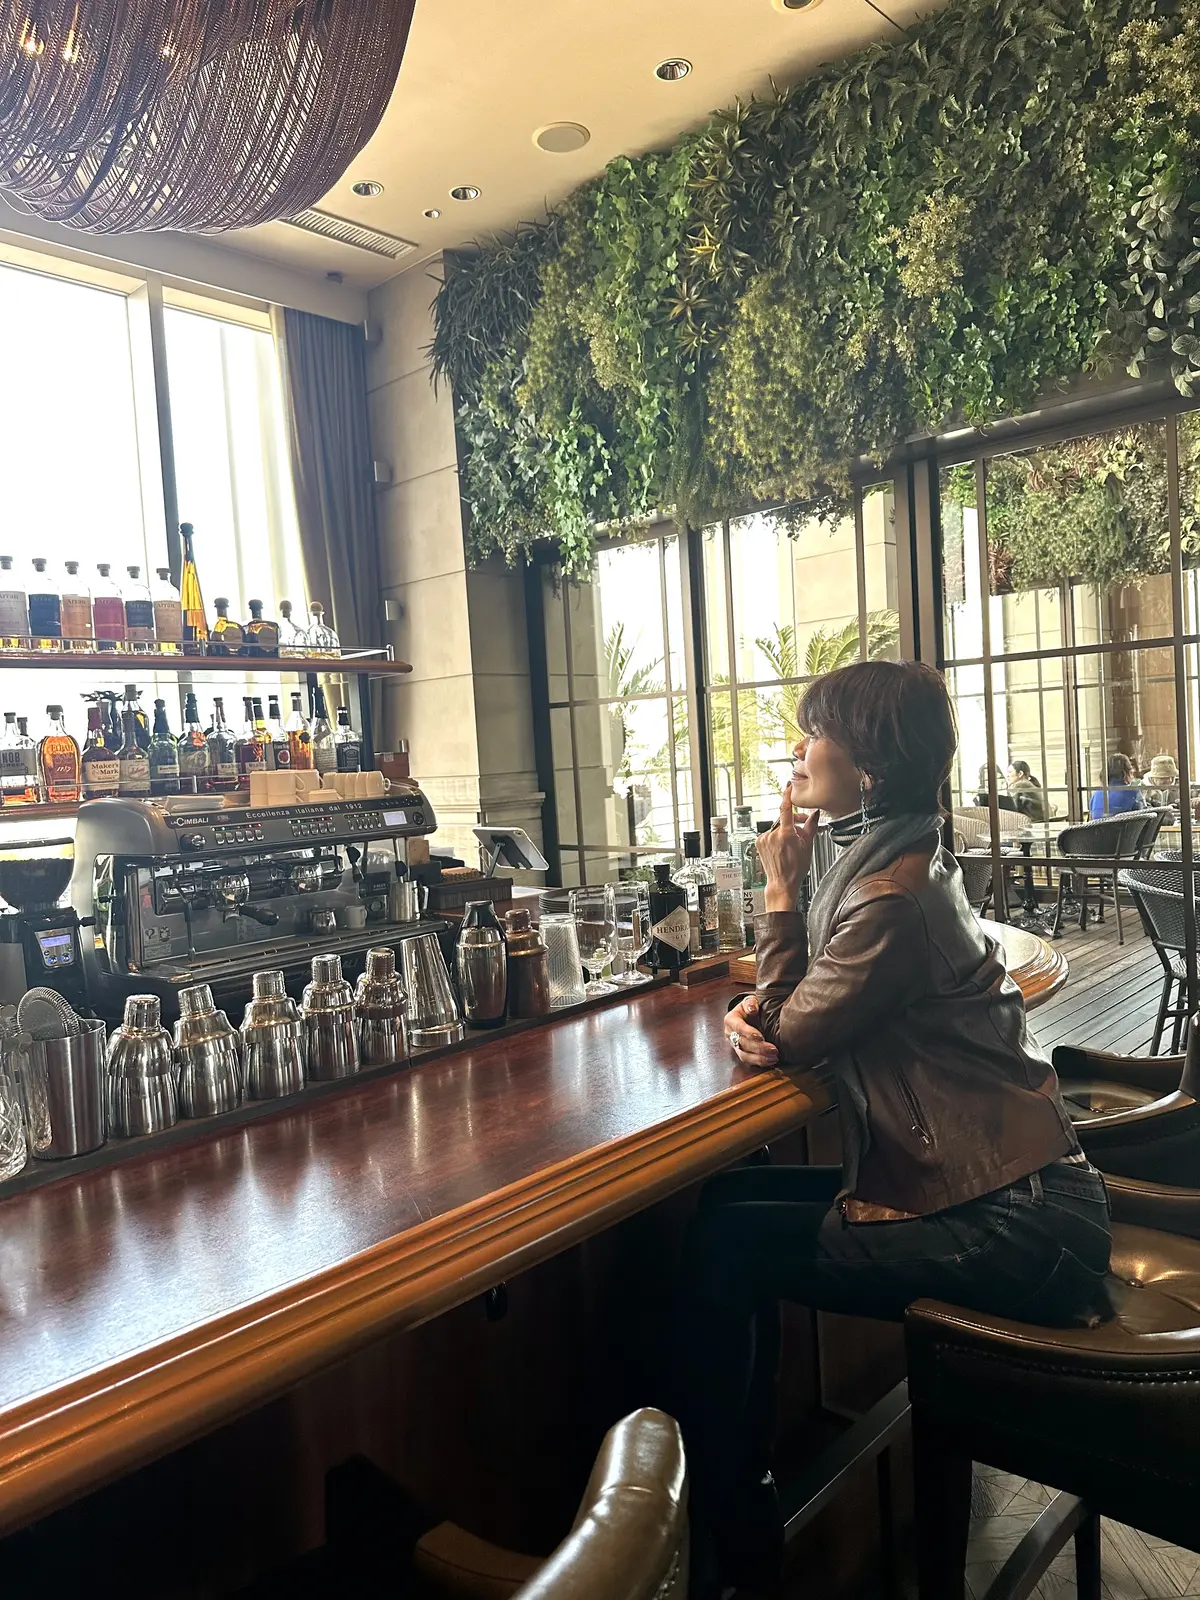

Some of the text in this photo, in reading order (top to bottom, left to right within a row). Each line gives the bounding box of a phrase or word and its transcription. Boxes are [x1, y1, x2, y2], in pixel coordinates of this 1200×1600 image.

[245, 810, 290, 819] Eccellenza
[176, 817, 209, 827] CIMBALI
[743, 898, 755, 914] 3
[656, 925, 689, 934] HENDRI
